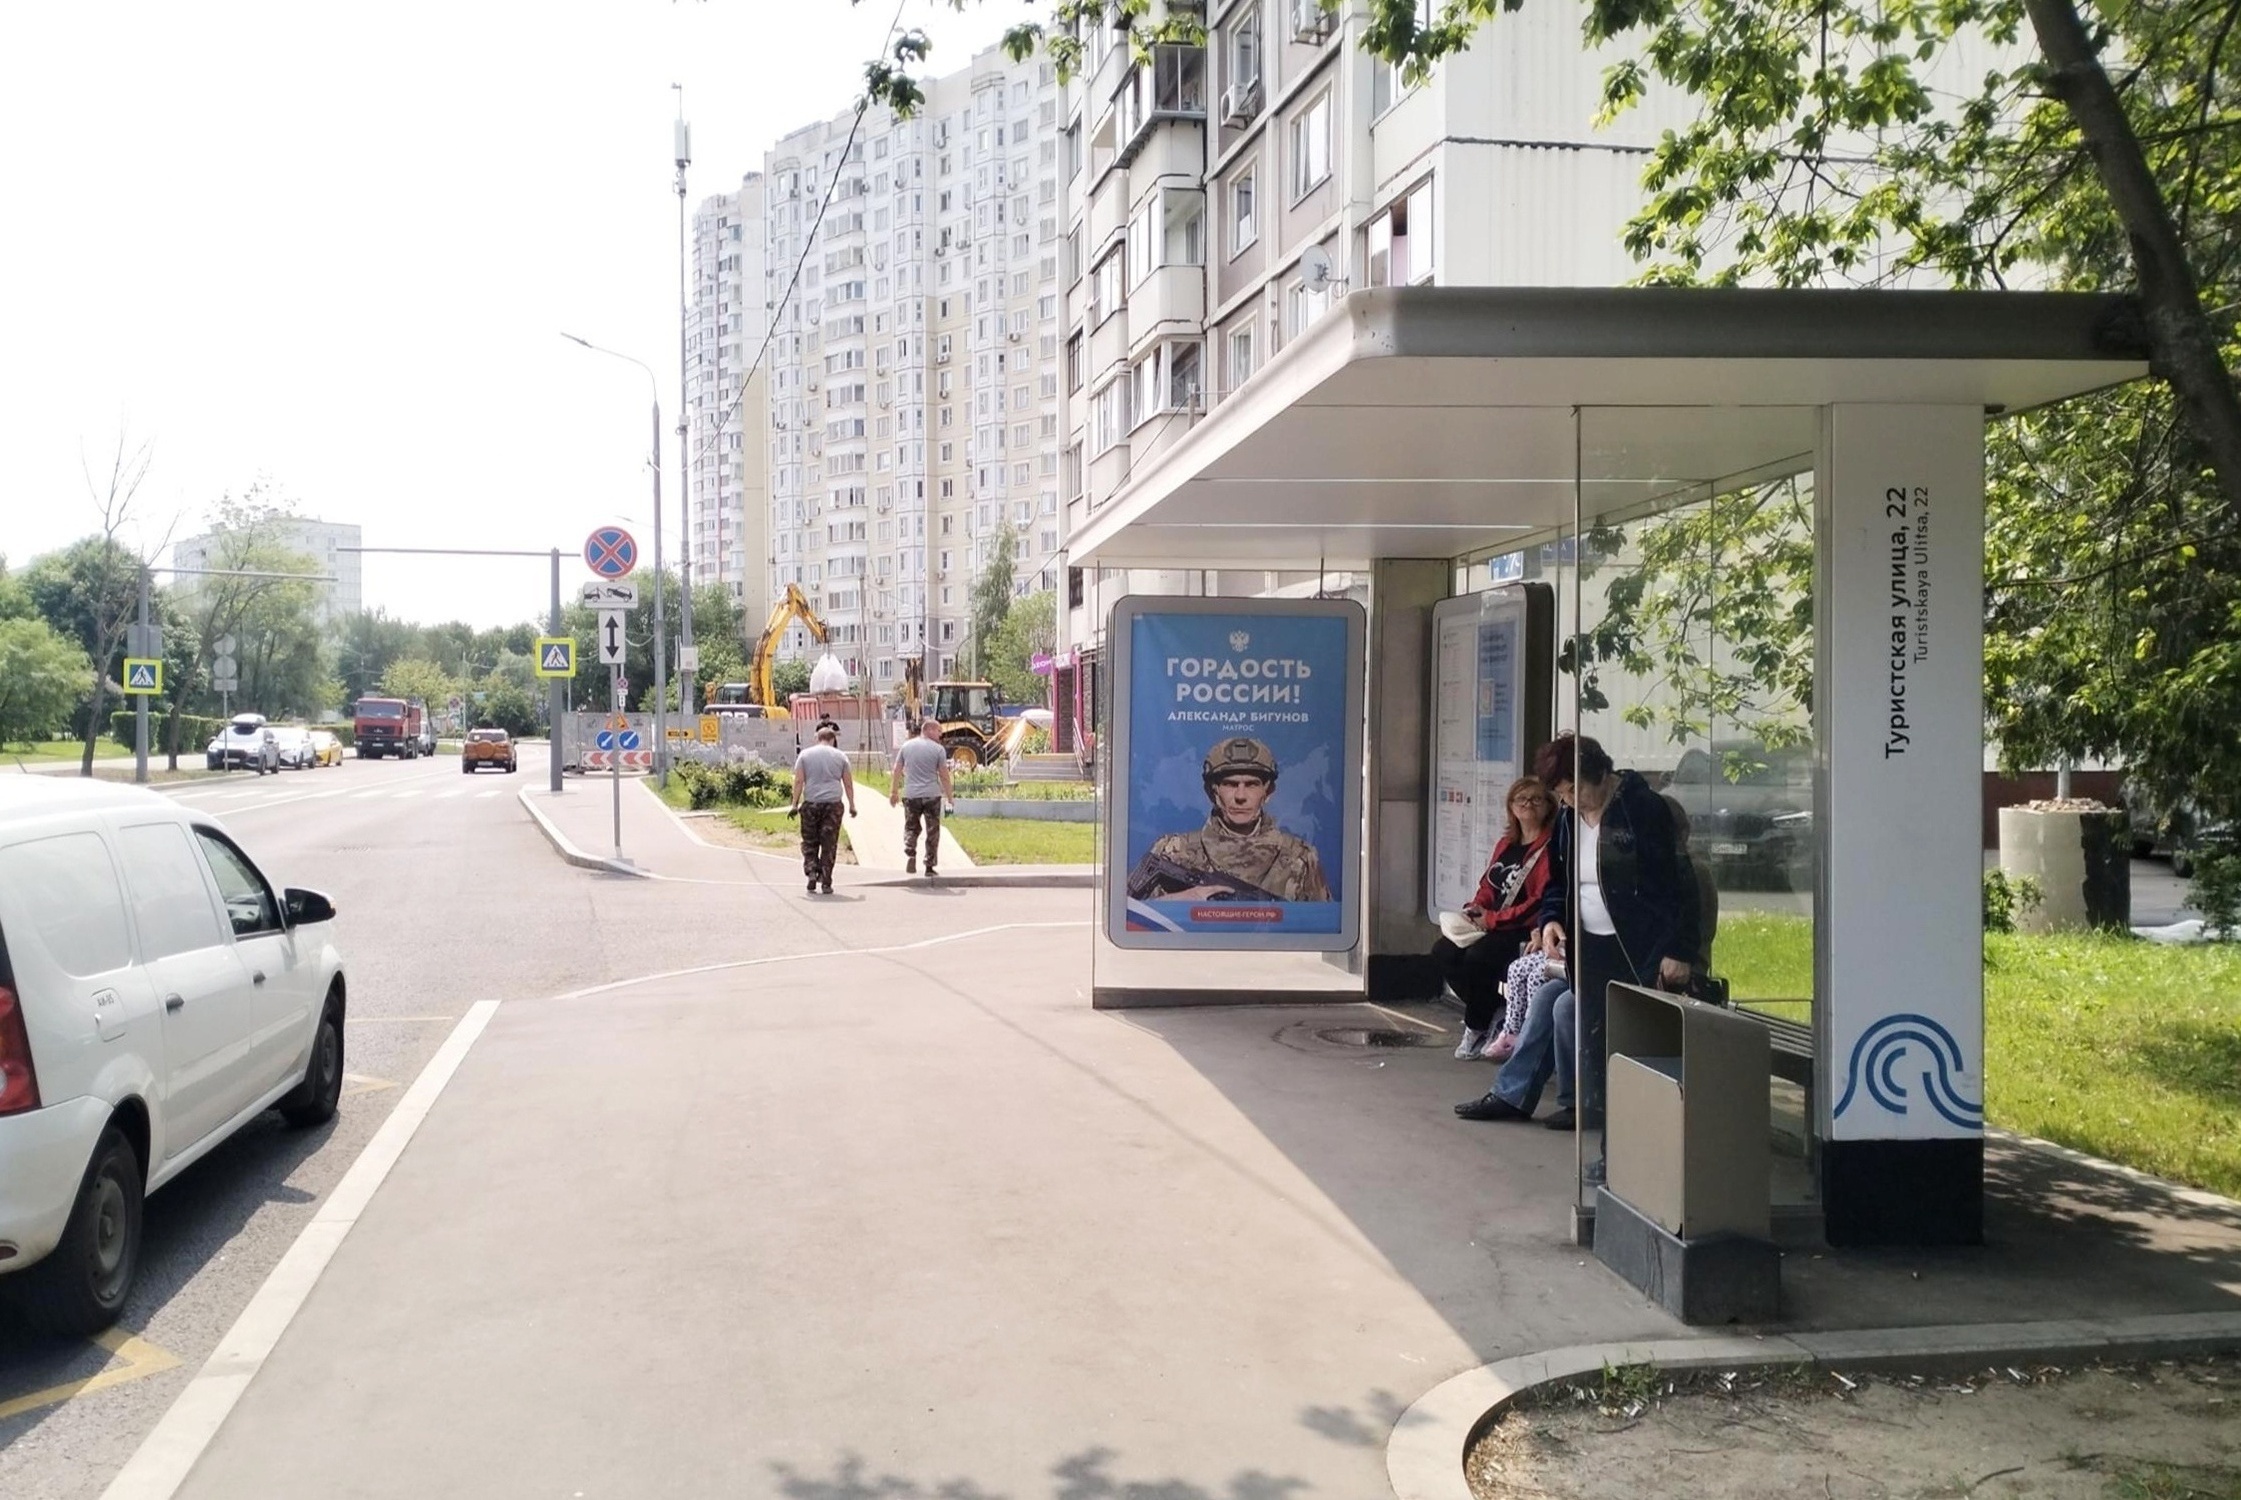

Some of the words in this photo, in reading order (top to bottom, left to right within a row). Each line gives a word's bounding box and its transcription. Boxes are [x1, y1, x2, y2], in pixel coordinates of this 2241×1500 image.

[1886, 487, 1906, 518] 22
[1913, 487, 1928, 507] 22
[1913, 511, 1930, 565] Ulitsa,
[1890, 525, 1911, 608] улица,
[1914, 570, 1931, 664] Turistskaya
[1166, 657, 1312, 680] ГОРДОСТЬ
[1176, 682, 1301, 704] РОССИИ!
[1885, 615, 1910, 760] Туристская
[1167, 710, 1247, 722] АЛЕКСАНДР
[1250, 711, 1309, 723] БИГУНОВ
[1222, 724, 1255, 732] МАТРОС
